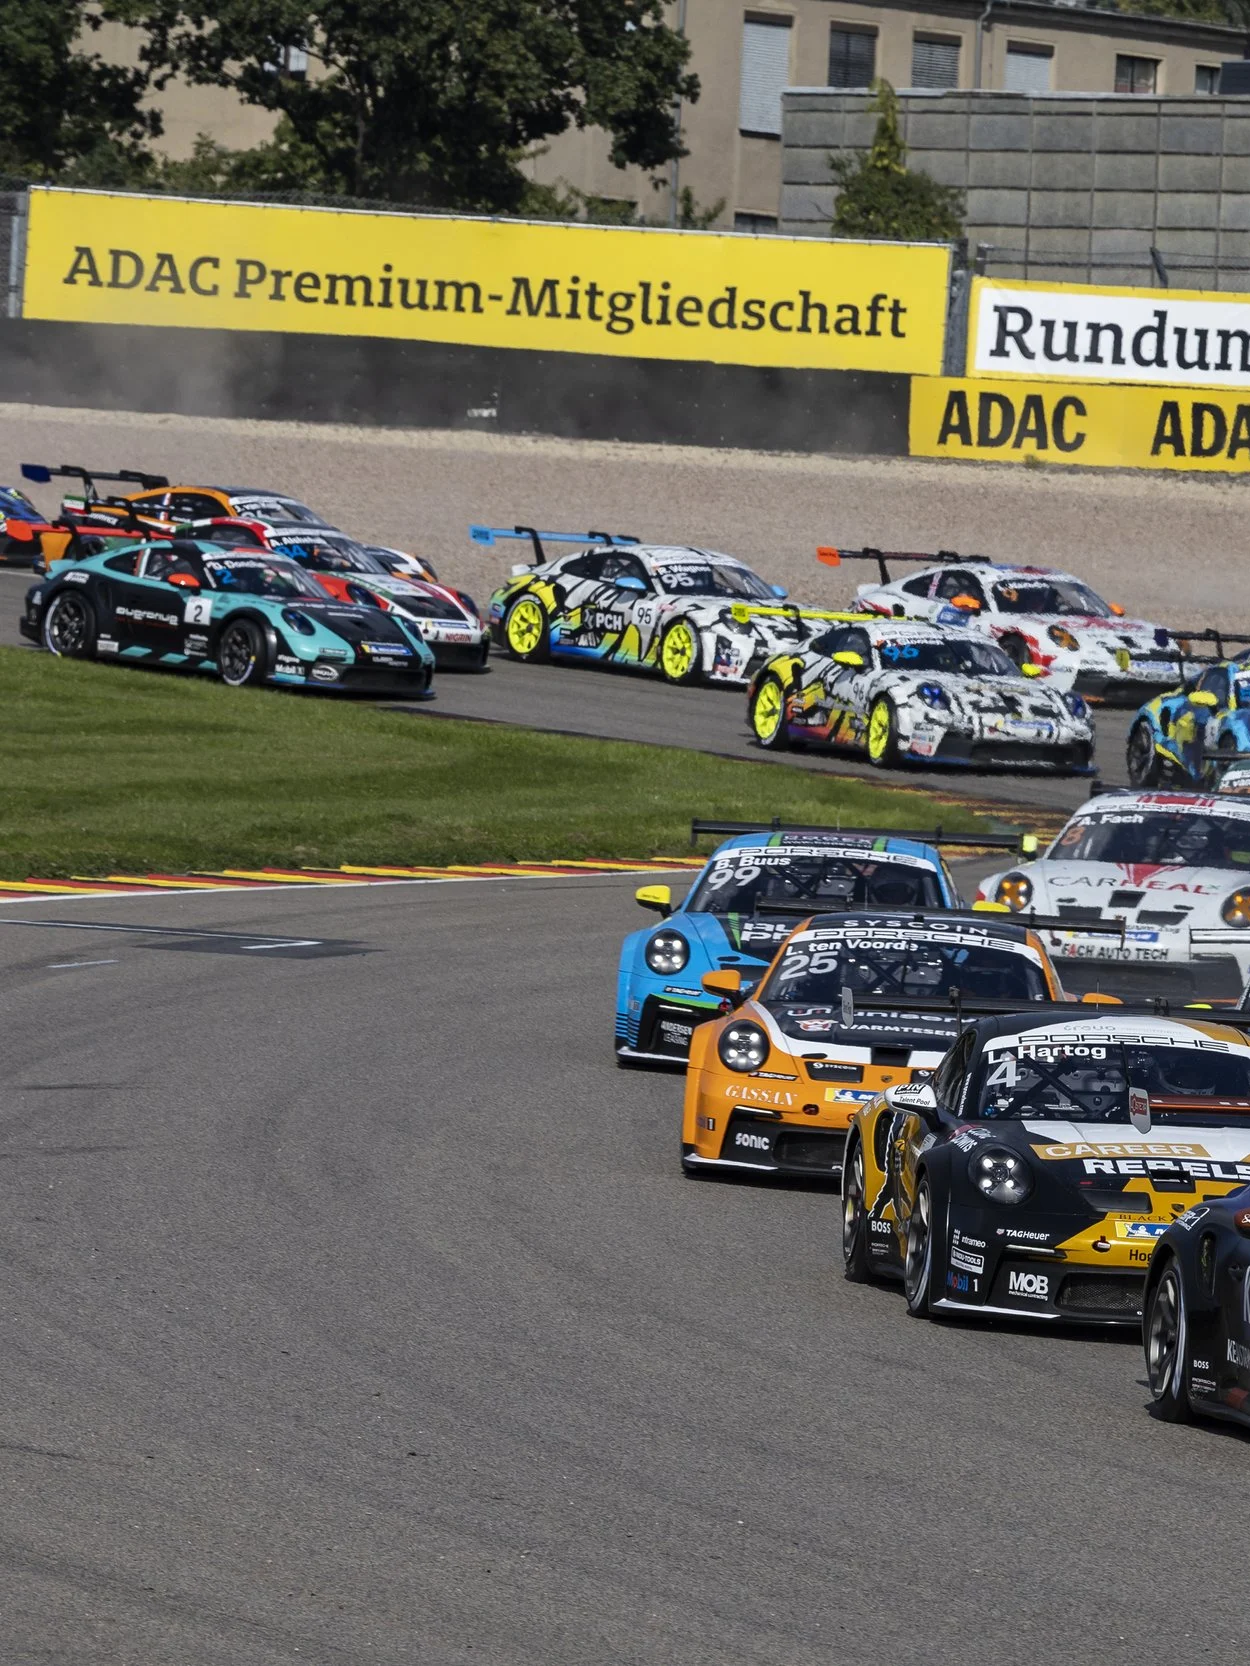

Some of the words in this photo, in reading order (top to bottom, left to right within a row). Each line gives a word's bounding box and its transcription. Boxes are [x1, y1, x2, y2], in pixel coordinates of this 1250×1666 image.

[62, 245, 220, 297] ADAC
[233, 257, 908, 340] Premium-Mitgliedschaft
[937, 389, 1088, 453] ADAC
[215, 569, 237, 584] 2
[661, 573, 695, 588] 95
[194, 605, 204, 622] 2
[595, 612, 623, 631] PCH
[637, 607, 653, 625] 95
[882, 645, 920, 662] 96
[1081, 815, 1096, 826] A.
[1099, 813, 1145, 824] Fach
[714, 858, 734, 871] B.
[738, 855, 792, 868] Buus
[738, 847, 918, 866] PORSCHE
[706, 866, 762, 892] 99
[843, 919, 989, 937] SYSCOIN
[786, 944, 803, 957] L.
[808, 939, 841, 952] ten
[845, 938, 919, 952] Voorde
[814, 929, 1016, 951] PORSCHE
[1062, 942, 1096, 958] FACH
[1100, 946, 1131, 960] AUTO
[1136, 948, 1170, 961] TECH
[779, 950, 839, 981] 25
[1018, 1034, 1230, 1052] PORSCHE
[1018, 1044, 1107, 1060] Hartog
[986, 1060, 1021, 1088] 4
[916, 1098, 931, 1107] Pool
[1044, 1143, 1197, 1160] CAREER
[1119, 1213, 1167, 1222] BLACK
[871, 1220, 892, 1235] BOSS
[947, 1271, 969, 1292] Mobil
[972, 1278, 979, 1292] 1
[1008, 1271, 1050, 1295] MOB
[1193, 1359, 1210, 1370] BOSS
